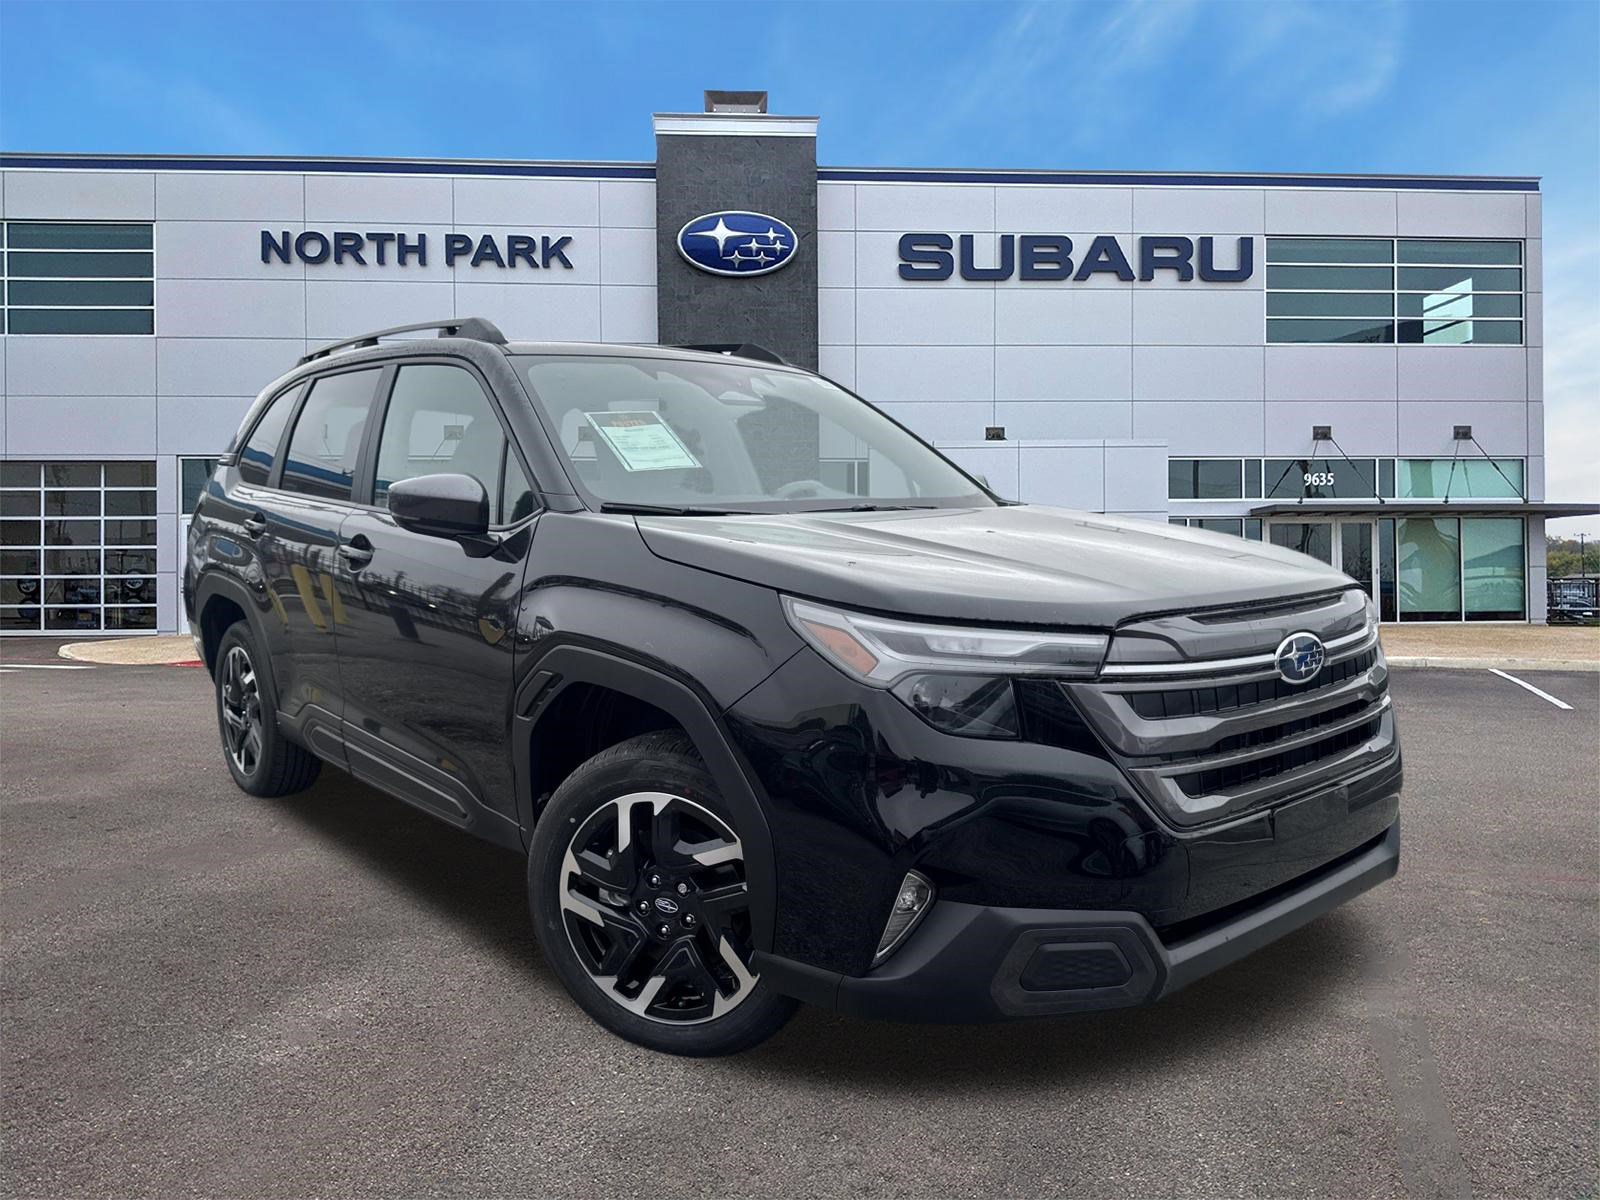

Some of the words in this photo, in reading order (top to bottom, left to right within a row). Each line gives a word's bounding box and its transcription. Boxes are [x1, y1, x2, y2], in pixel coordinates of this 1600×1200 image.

[261, 230, 427, 266] NORTH
[444, 233, 574, 269] PARK
[898, 233, 1254, 282] SUBARU
[1303, 472, 1335, 486] 9635
